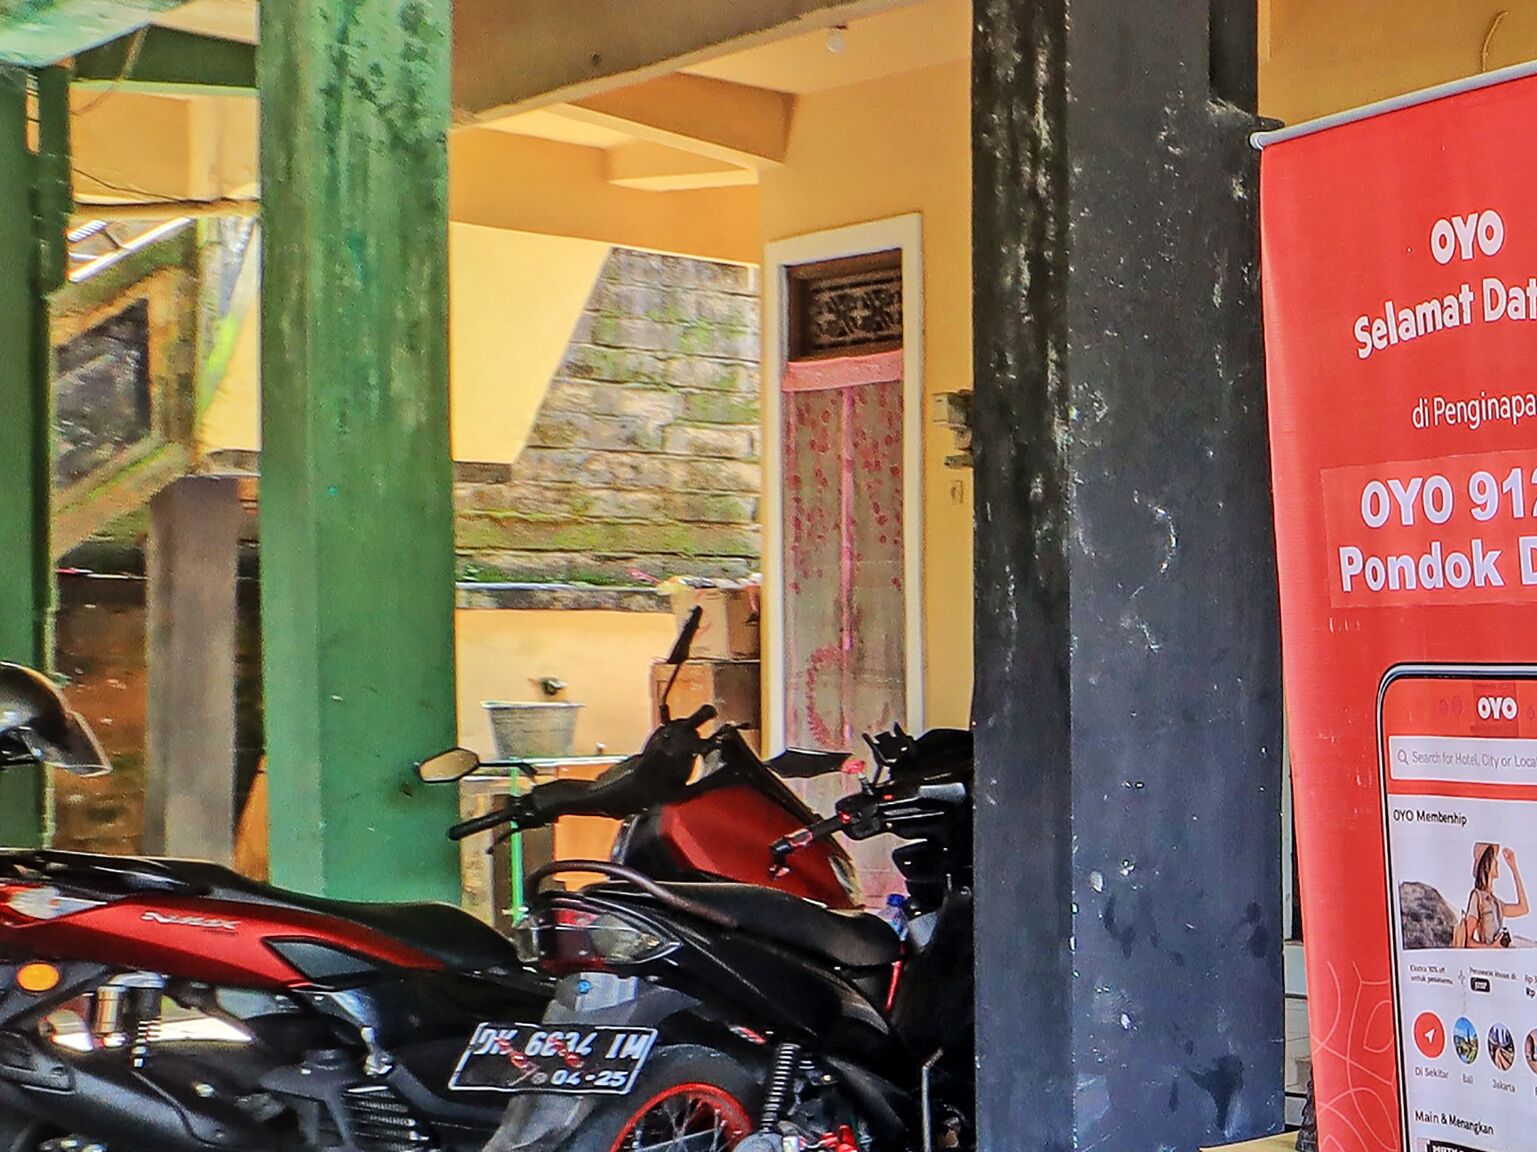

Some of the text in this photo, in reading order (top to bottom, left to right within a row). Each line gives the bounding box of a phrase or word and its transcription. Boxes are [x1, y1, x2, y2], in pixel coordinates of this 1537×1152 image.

[1430, 209, 1504, 264] OYO
[1354, 284, 1474, 359] Selamat
[1412, 399, 1429, 428] di
[1360, 475, 1454, 528] OYO
[1339, 539, 1505, 592] Pondok
[1477, 697, 1518, 719] OYO
[1412, 751, 1441, 764] Search
[1442, 752, 1453, 764] for
[1456, 753, 1480, 766] Hotel,
[1482, 753, 1499, 769] City
[1501, 757, 1511, 765] or
[1393, 810, 1467, 827] OYO Membership
[1525, 975, 1532, 984] Rp
[1526, 988, 1535, 998] Rp
[1415, 1067, 1449, 1078] Di Sekitar
[1492, 1079, 1515, 1092] Jakarta
[1415, 1111, 1493, 1135] Main & Menangkan
